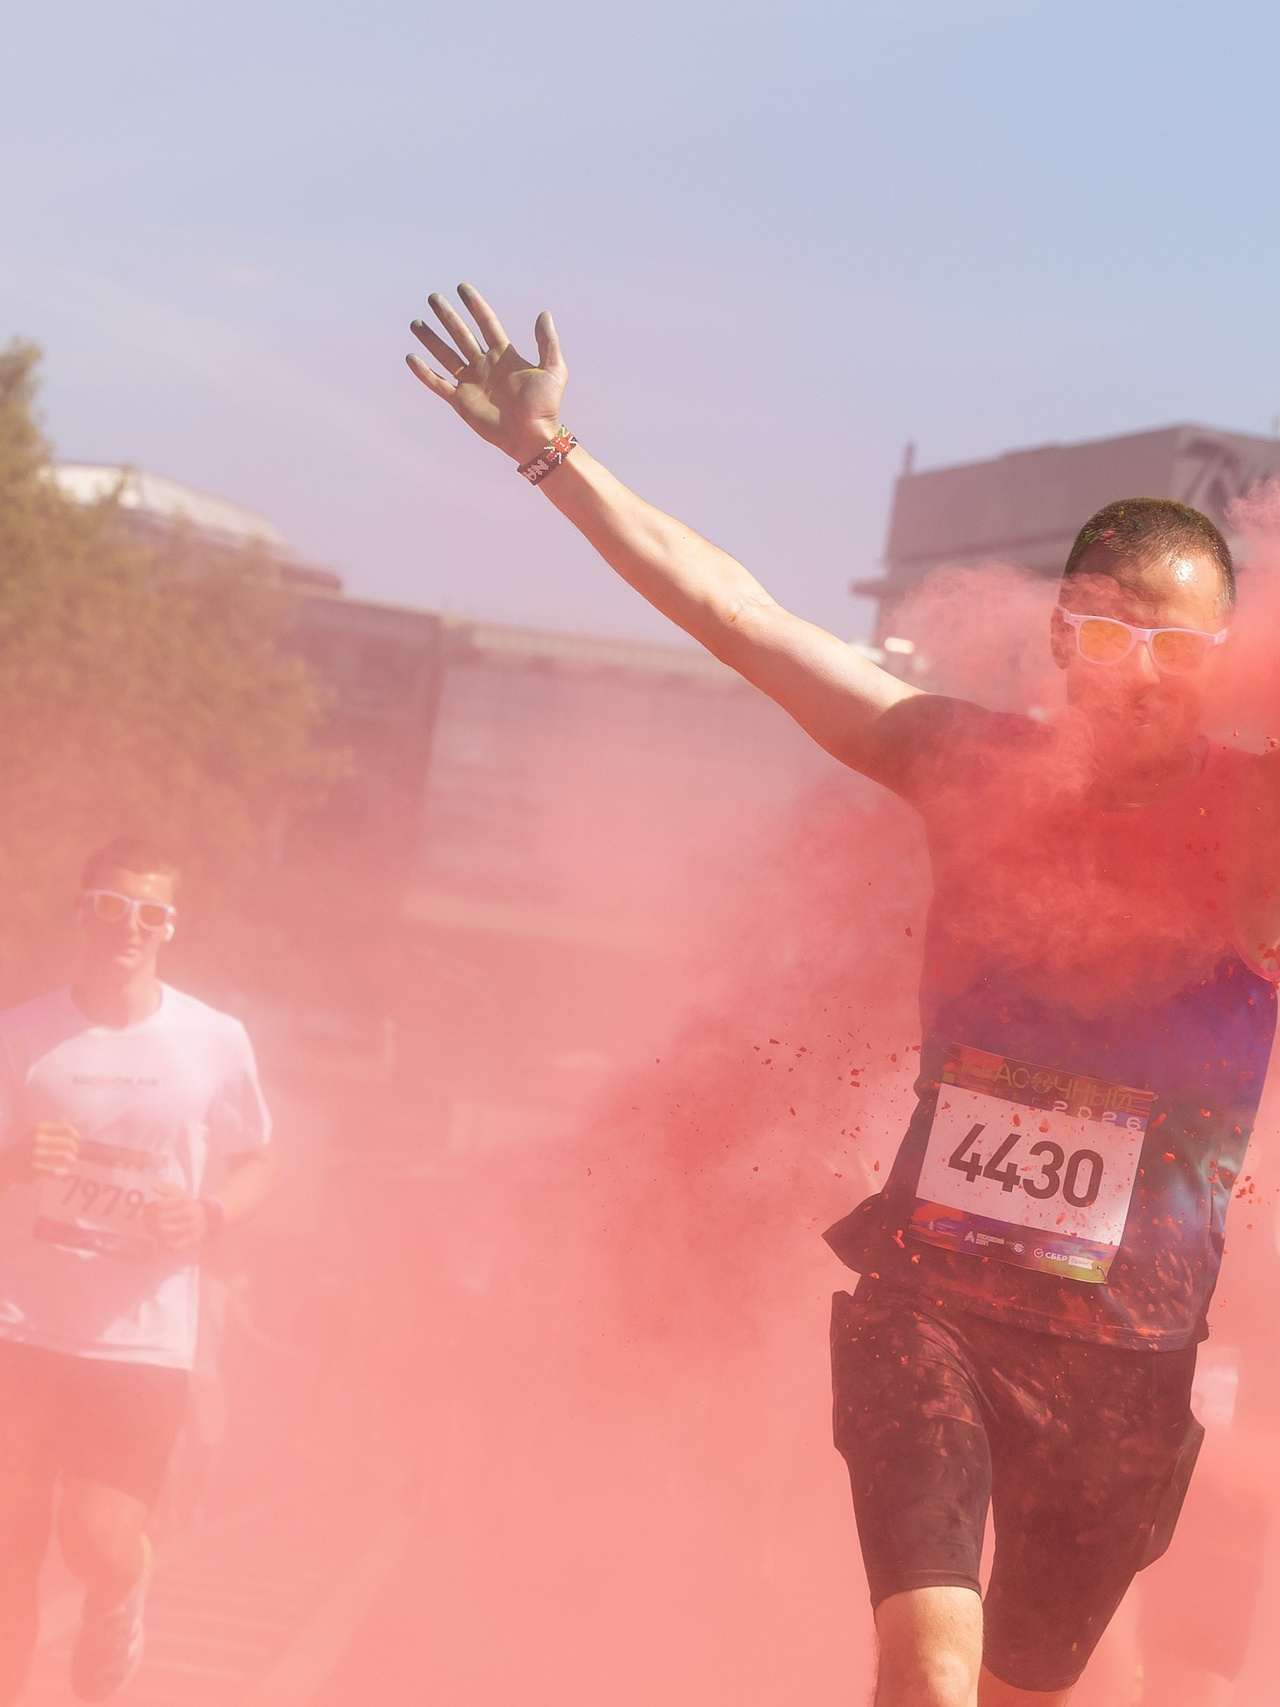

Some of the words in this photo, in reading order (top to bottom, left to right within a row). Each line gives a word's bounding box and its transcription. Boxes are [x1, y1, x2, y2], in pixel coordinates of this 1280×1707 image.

[1052, 1100, 1141, 1130] 2026
[948, 1123, 1104, 1207] 4430
[62, 1175, 144, 1220] 7979
[1045, 1251, 1067, 1262] СБЕР
